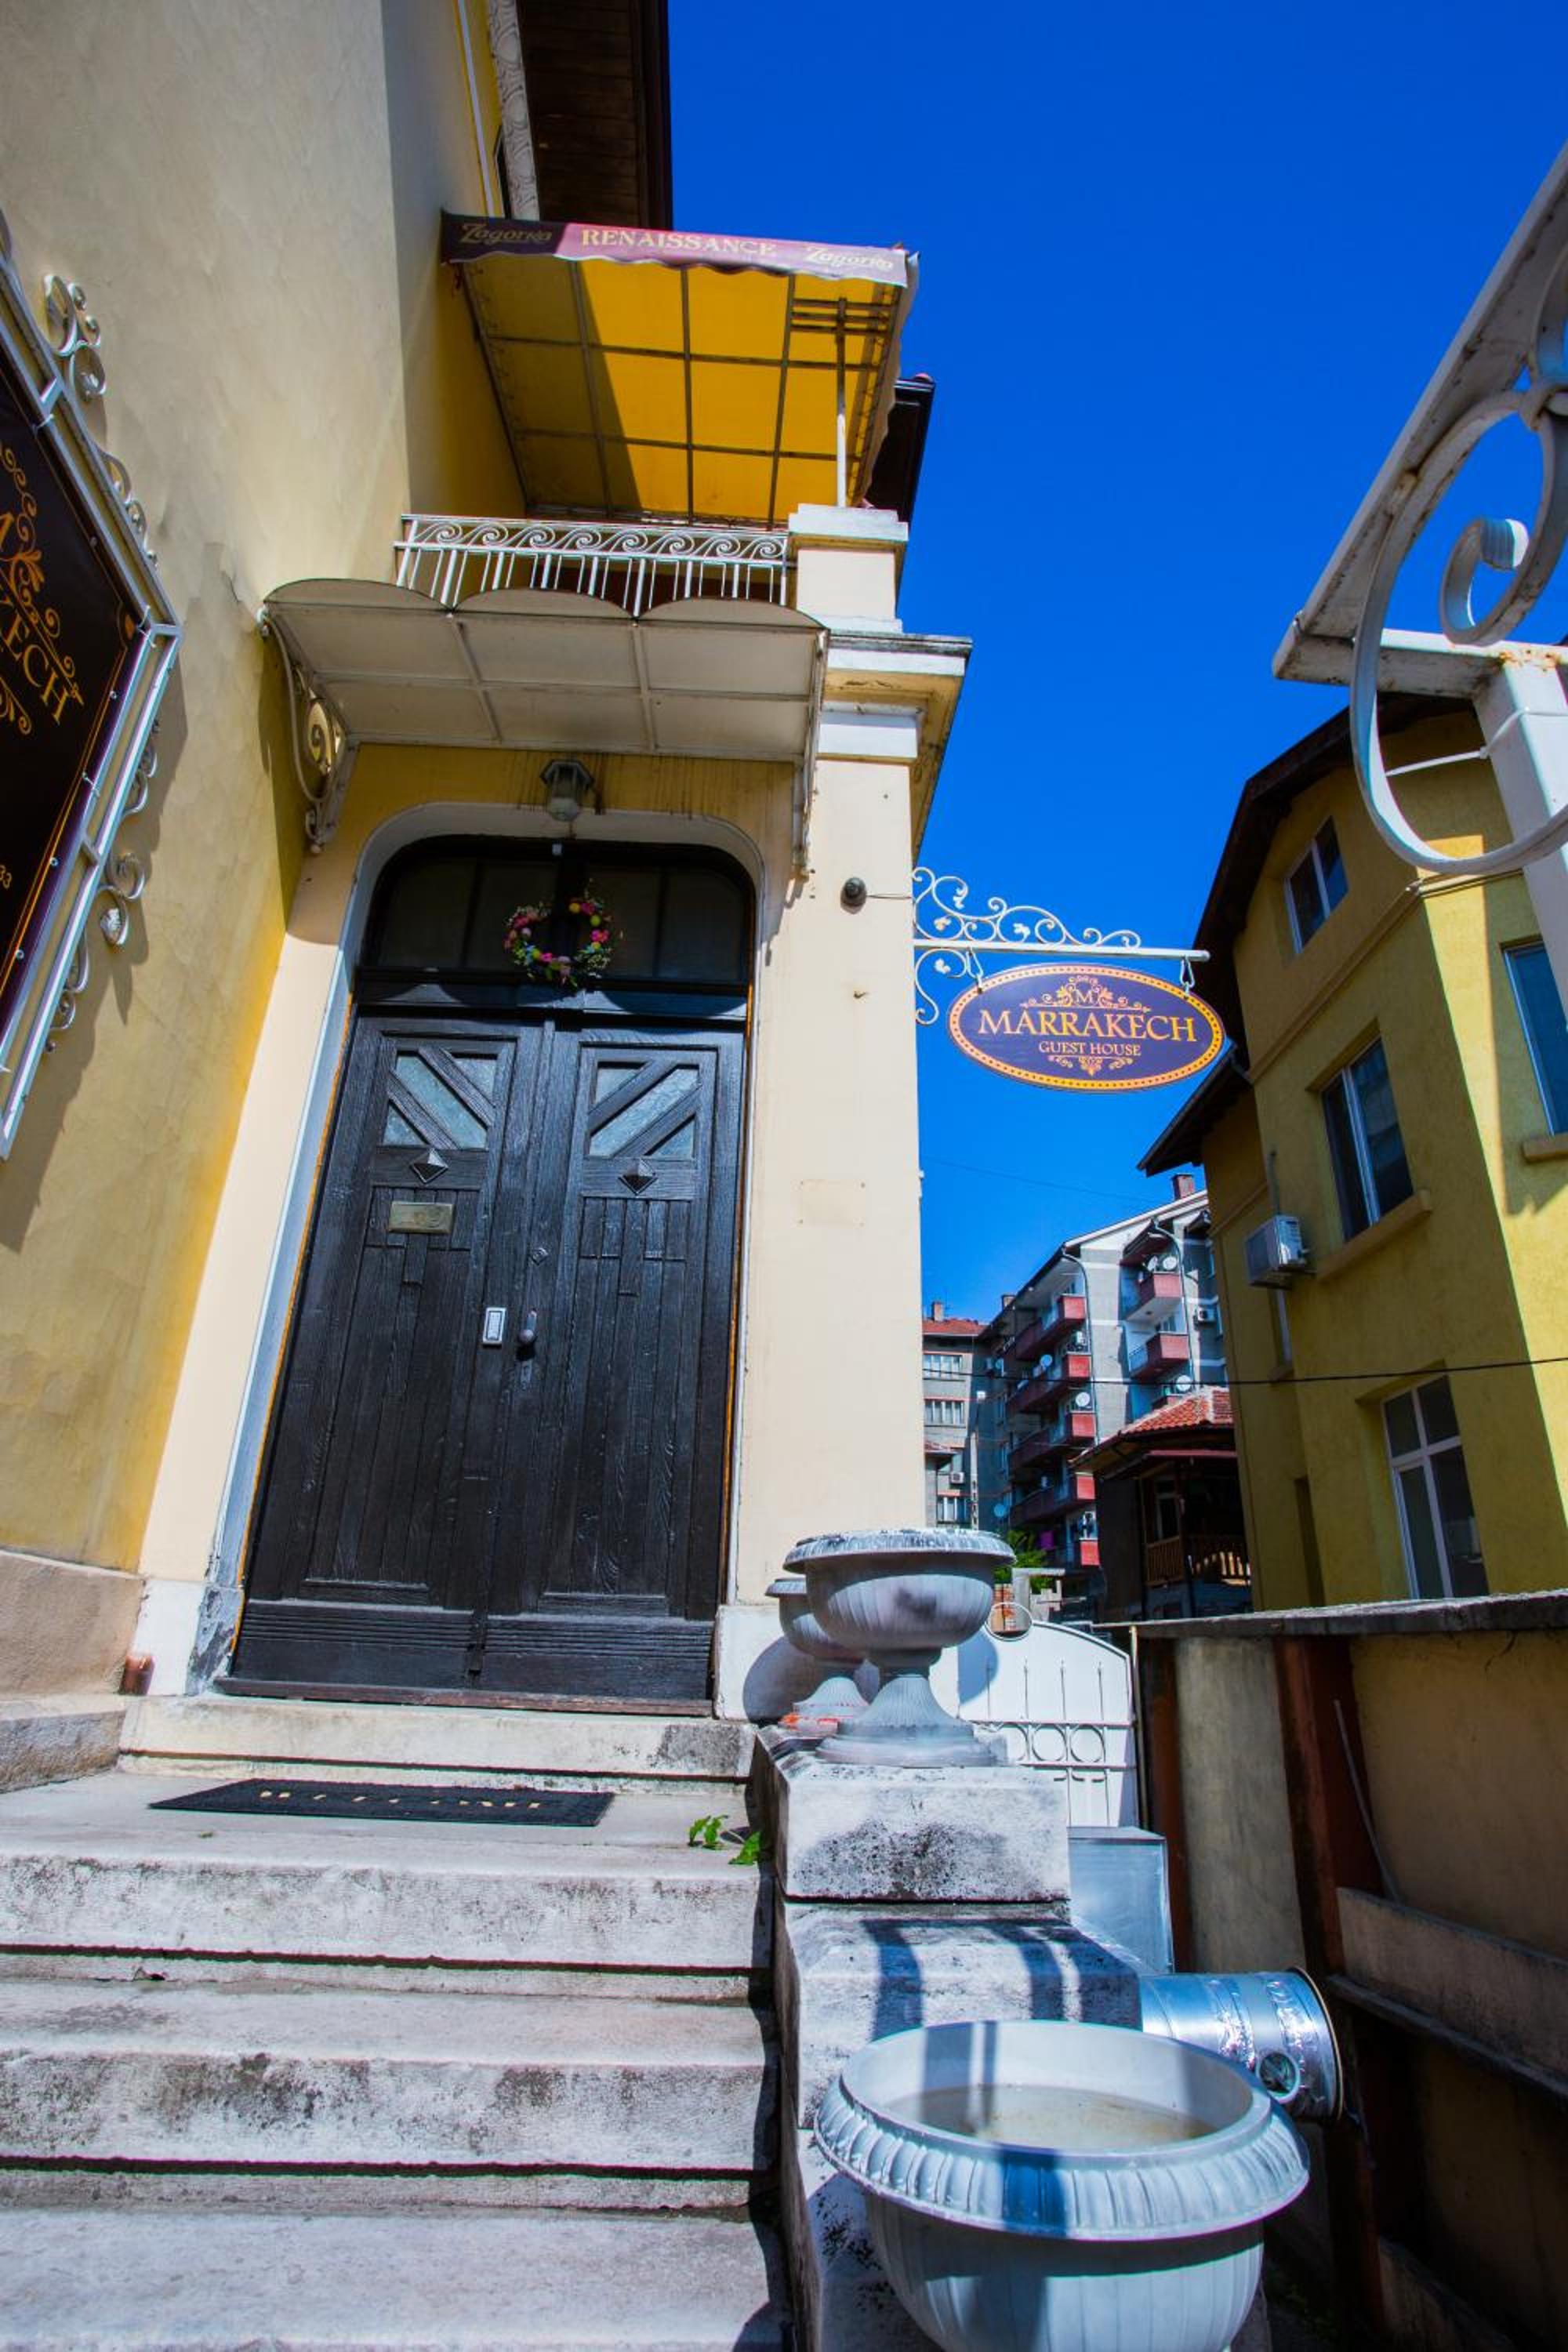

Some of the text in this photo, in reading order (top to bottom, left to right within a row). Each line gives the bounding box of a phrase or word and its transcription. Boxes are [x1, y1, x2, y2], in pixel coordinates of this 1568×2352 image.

[581, 229, 777, 256] RENAISSANCE
[804, 246, 894, 271] Zagorka
[1076, 989, 1094, 1004] M
[978, 1010, 1197, 1042] MARRAKECH
[1038, 1041, 1142, 1056] GUEST HOUSE
